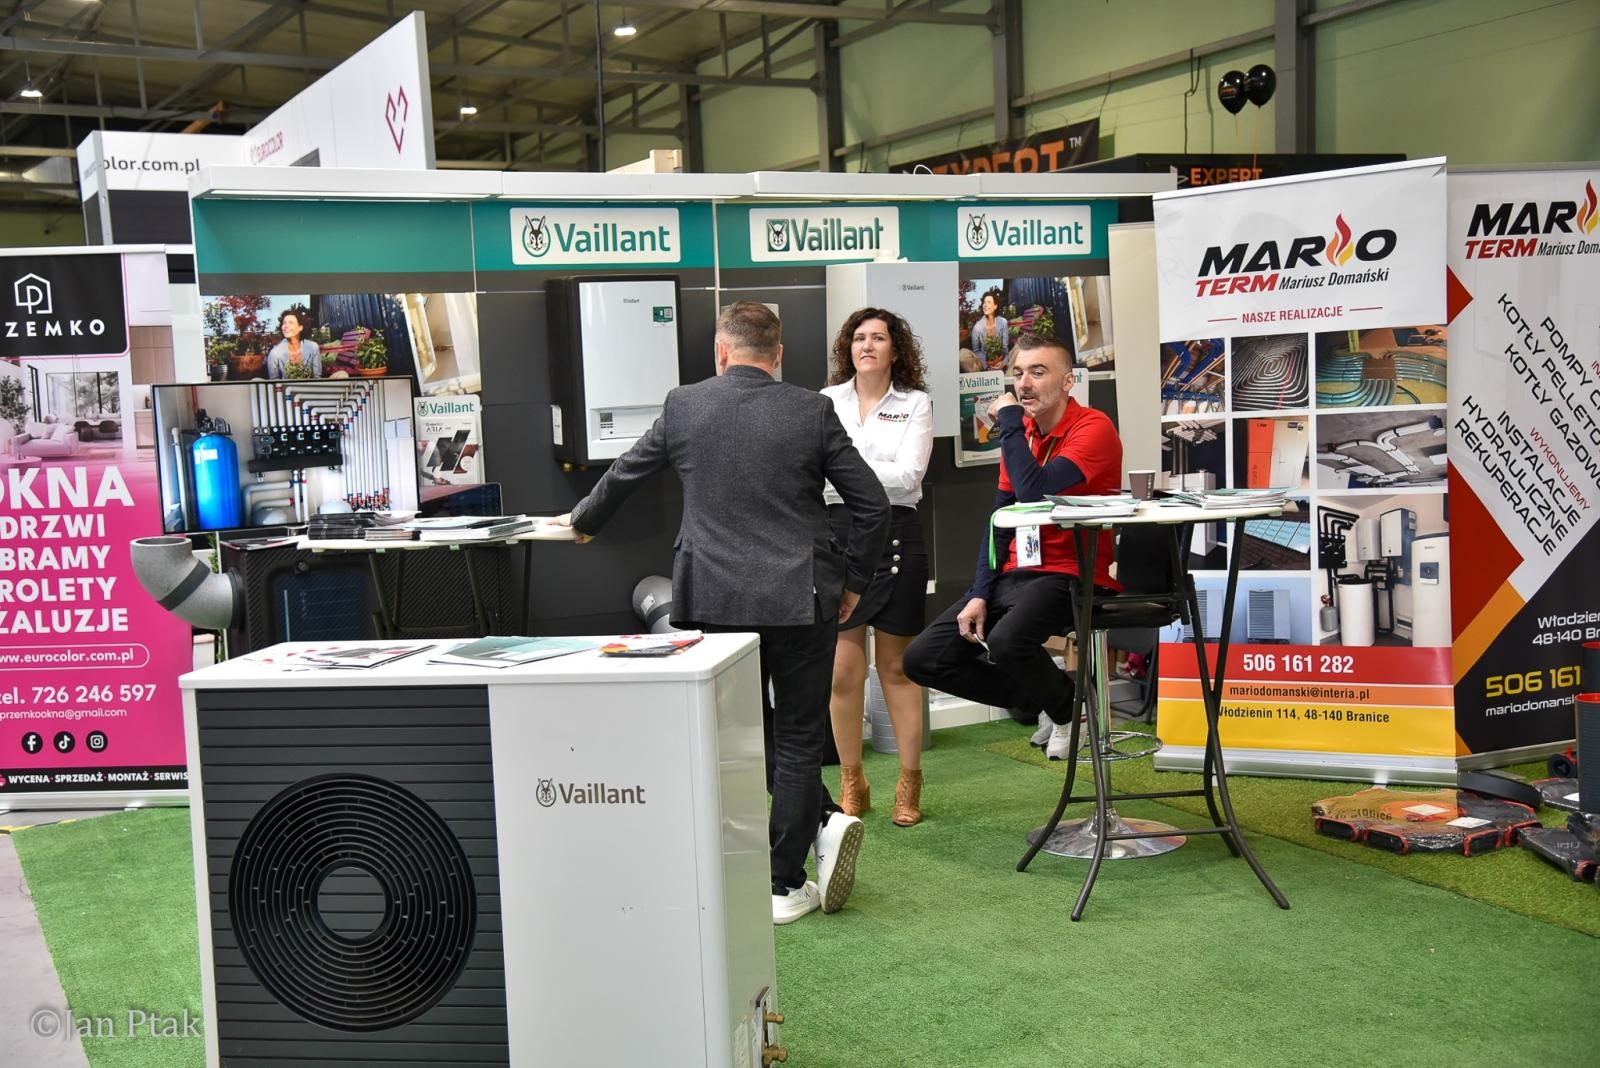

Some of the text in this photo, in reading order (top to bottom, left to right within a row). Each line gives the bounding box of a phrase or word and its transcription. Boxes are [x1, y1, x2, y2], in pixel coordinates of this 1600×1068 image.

[1190, 167, 1263, 185] EXPERT
[554, 223, 671, 252] Vaillant
[789, 217, 884, 252] Vaillant
[991, 219, 1083, 247] Vaillant
[1465, 238, 1600, 260] TERM Mariusz Dom
[1195, 268, 1389, 298] TERM Mariusz Domański
[1242, 305, 1343, 323] NASZE REALIZACJE
[1498, 293, 1546, 355] KOTŁY
[5, 319, 105, 338] ZEMKO
[1540, 316, 1593, 386] POMPY
[965, 376, 1000, 388] Vaillant
[1504, 343, 1552, 405] KOTŁY
[429, 402, 475, 414] Vaillant
[1462, 395, 1568, 541] HYDRAULICZNE
[1497, 410, 1581, 526] INSTALACJE
[1529, 427, 1590, 511] WYKONUJEMY
[0, 466, 135, 510] KNA
[1455, 418, 1556, 556] REKUPERACJE
[0, 514, 106, 540] DRZWI
[0, 545, 111, 572] BRAMY
[0, 577, 117, 603] ROLETY
[1532, 629, 1581, 645] 48-140
[1243, 654, 1354, 674] 506 161 282
[0, 684, 157, 705] el. 726 246 597
[1230, 686, 1370, 700] mariodomanski@interia.pl
[1485, 665, 1581, 698] 506 161
[1277, 708, 1300, 720] 114,
[1304, 709, 1343, 722] 48-140
[1346, 710, 1390, 723] Branice
[8, 771, 188, 784] WYCENA SPRZEDAŻ MONTAŻ SERWIS
[558, 783, 646, 804] Vaillant
